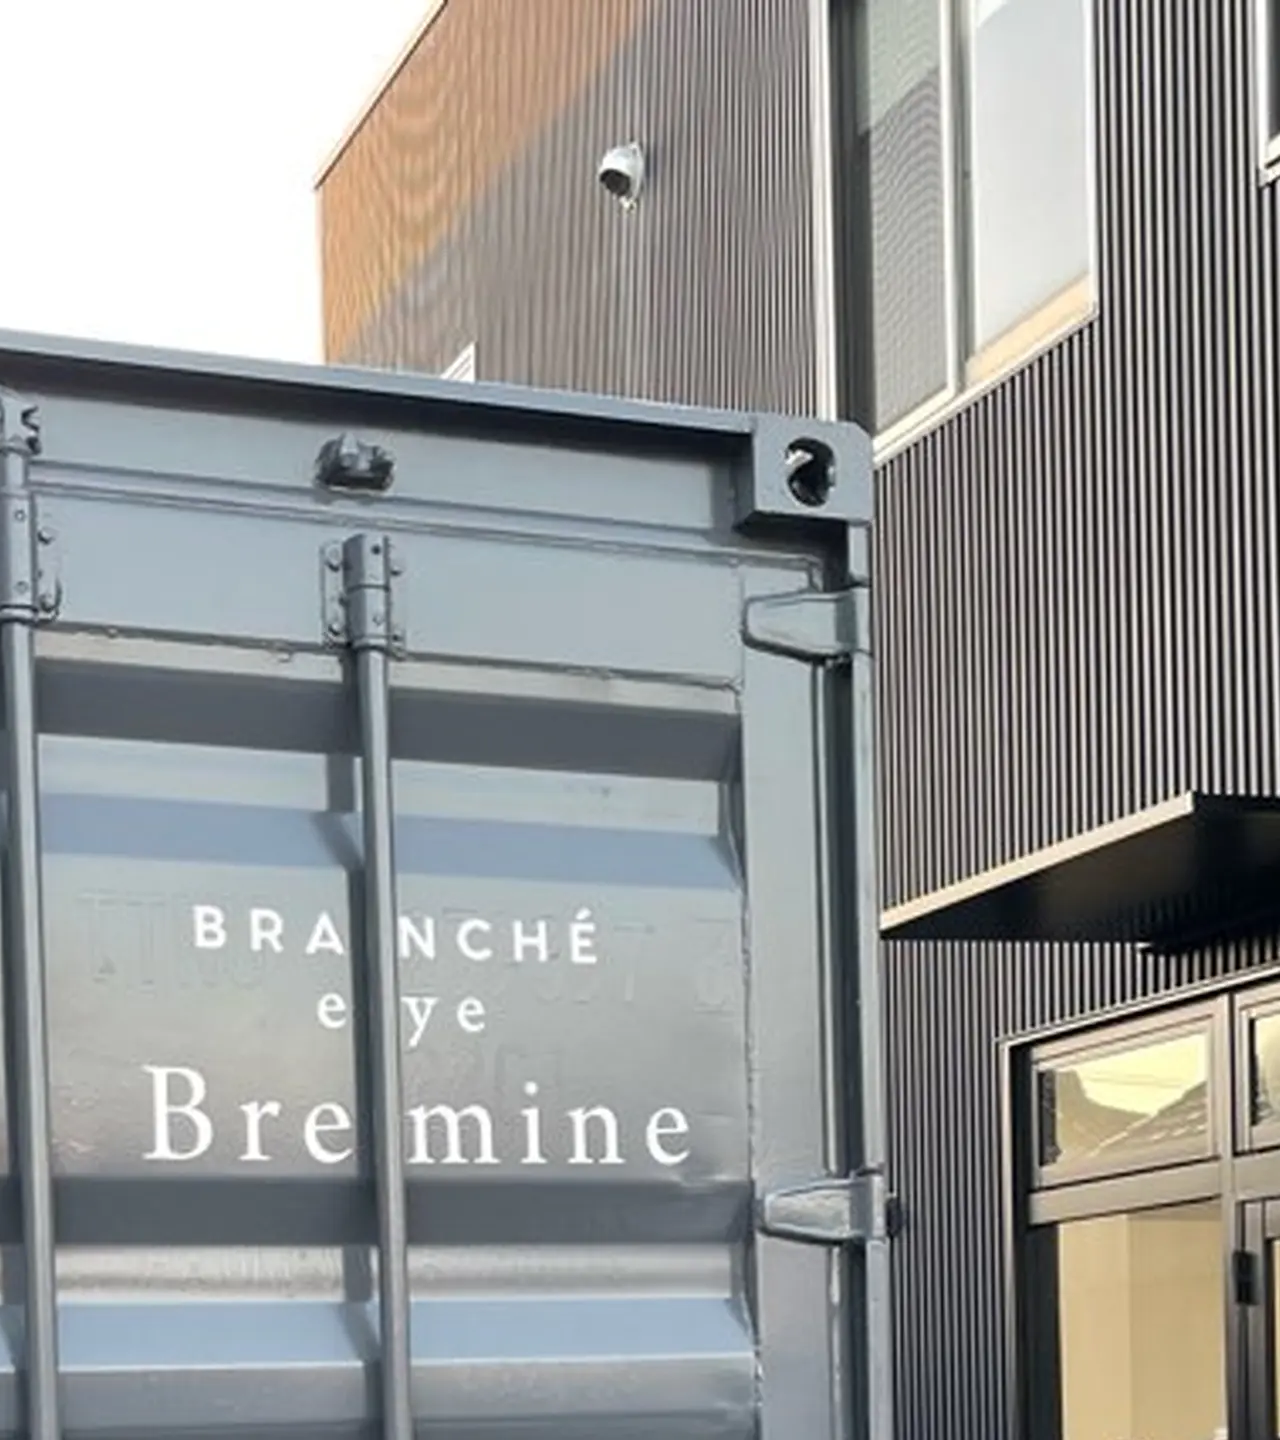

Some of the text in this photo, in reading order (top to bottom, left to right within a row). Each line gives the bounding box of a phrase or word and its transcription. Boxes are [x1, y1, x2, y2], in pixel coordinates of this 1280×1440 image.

[192, 905, 598, 965] BRANCHÉ
[316, 992, 487, 1048] eye
[141, 1063, 692, 1165] Bremine
